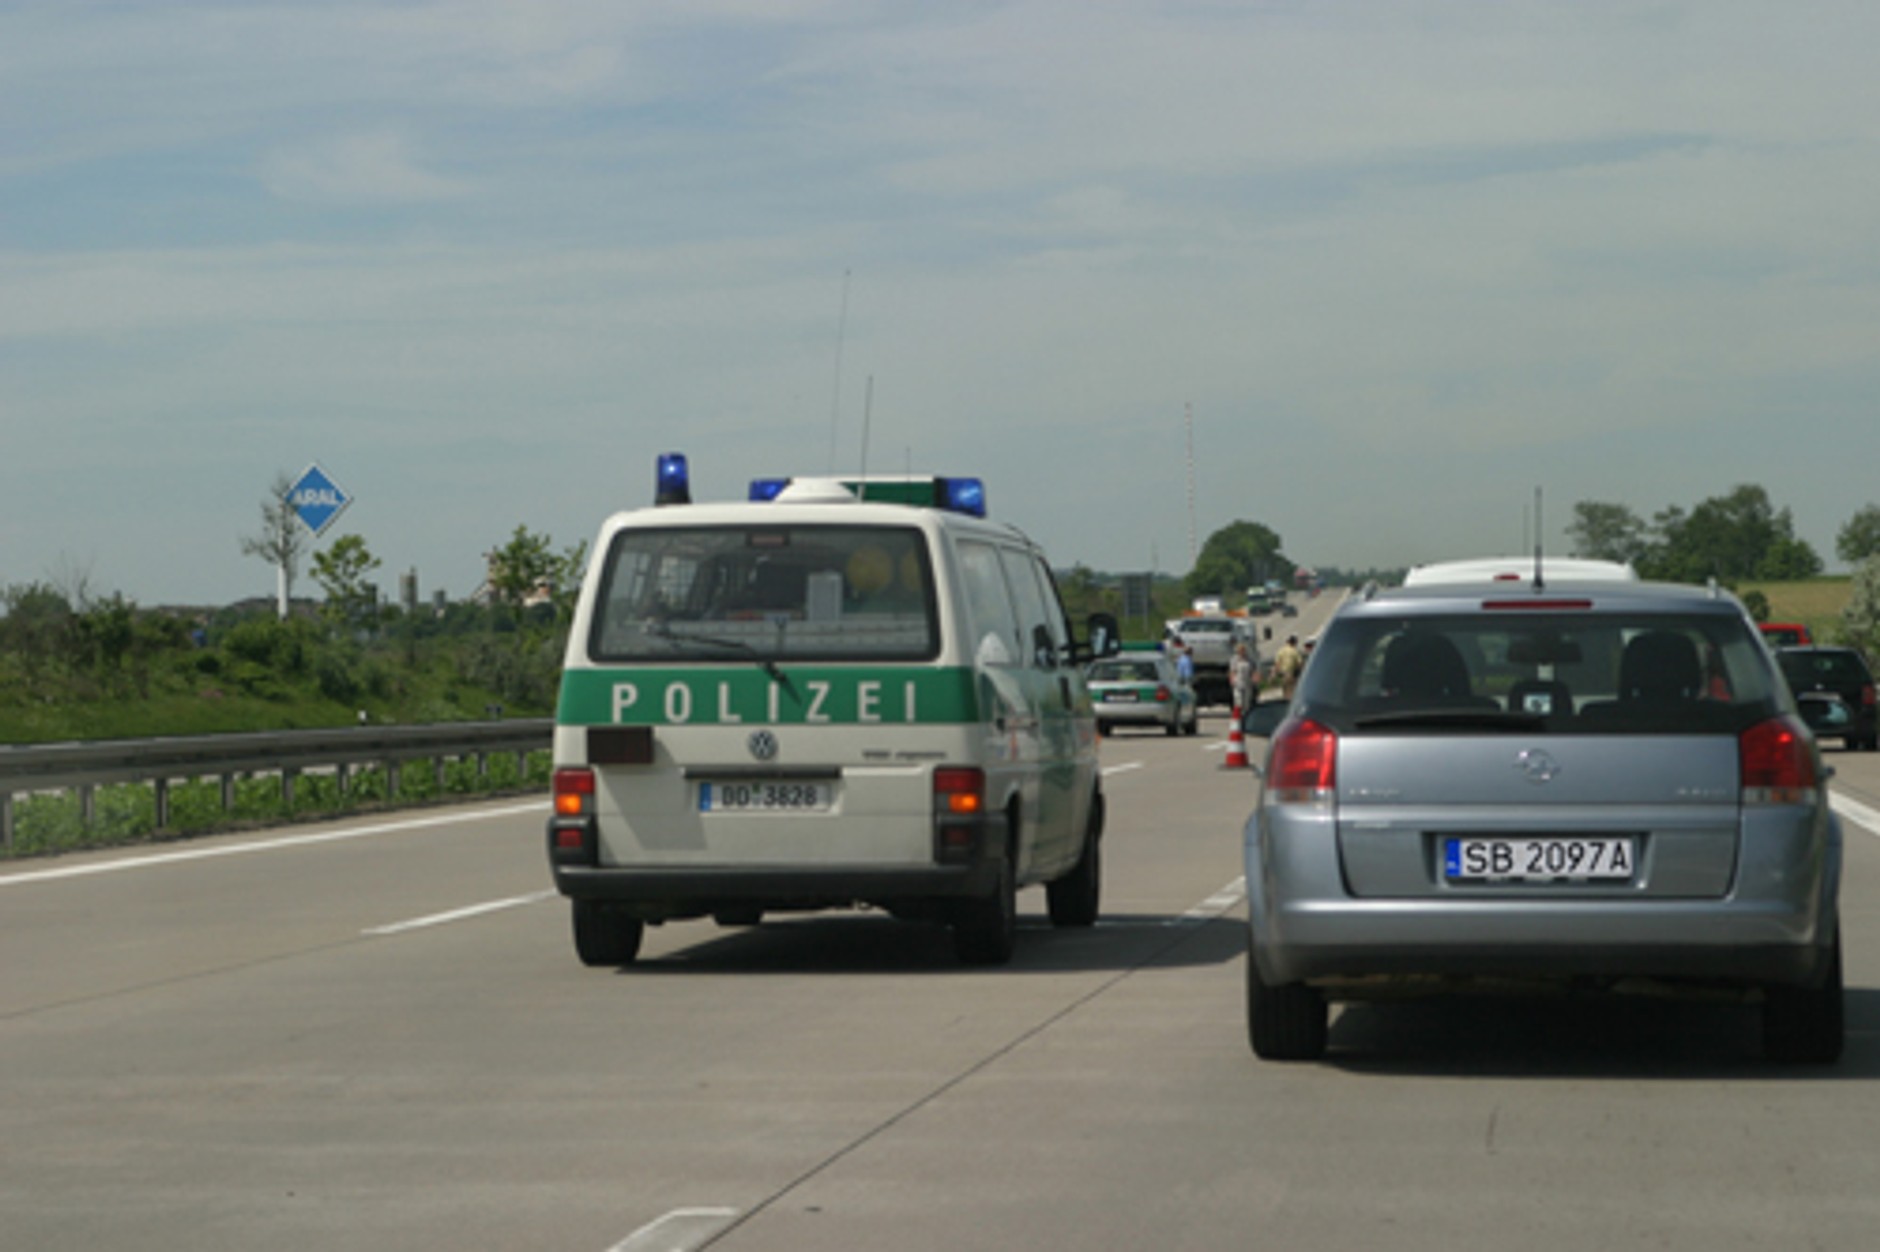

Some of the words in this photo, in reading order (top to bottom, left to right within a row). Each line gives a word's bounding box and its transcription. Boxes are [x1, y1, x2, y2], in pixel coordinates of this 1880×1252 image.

[291, 489, 339, 506] ARAL
[611, 681, 916, 723] POLIZEI
[1465, 841, 1513, 874] SB
[1526, 841, 1629, 874] 2097A
